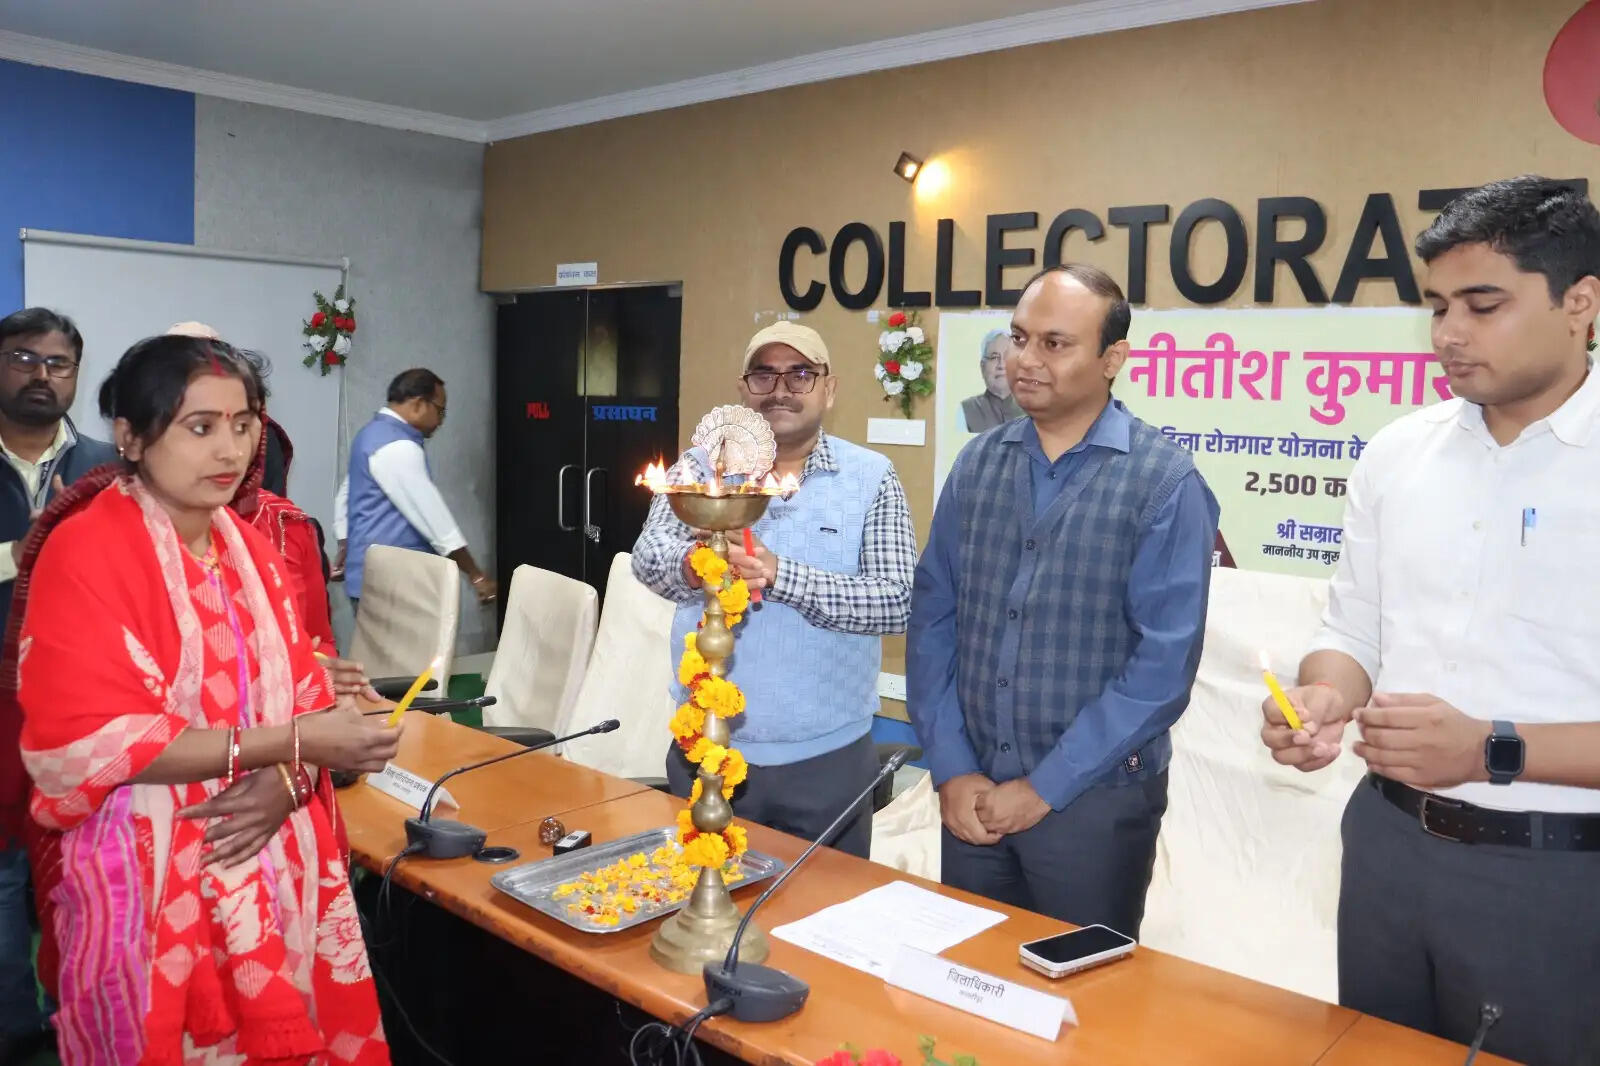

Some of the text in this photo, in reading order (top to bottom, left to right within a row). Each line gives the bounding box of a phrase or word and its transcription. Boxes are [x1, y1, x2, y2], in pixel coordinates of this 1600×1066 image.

[778, 177, 1589, 312] COLLECTORA
[1128, 332, 1291, 401] नीतीश
[1205, 428, 1275, 456] रोजगार
[1277, 432, 1345, 460] योजना
[1245, 471, 1317, 496] 2,500
[1277, 519, 1344, 544] श्री सम्राट
[1262, 544, 1304, 559] माननीय
[1306, 548, 1320, 560] उप
